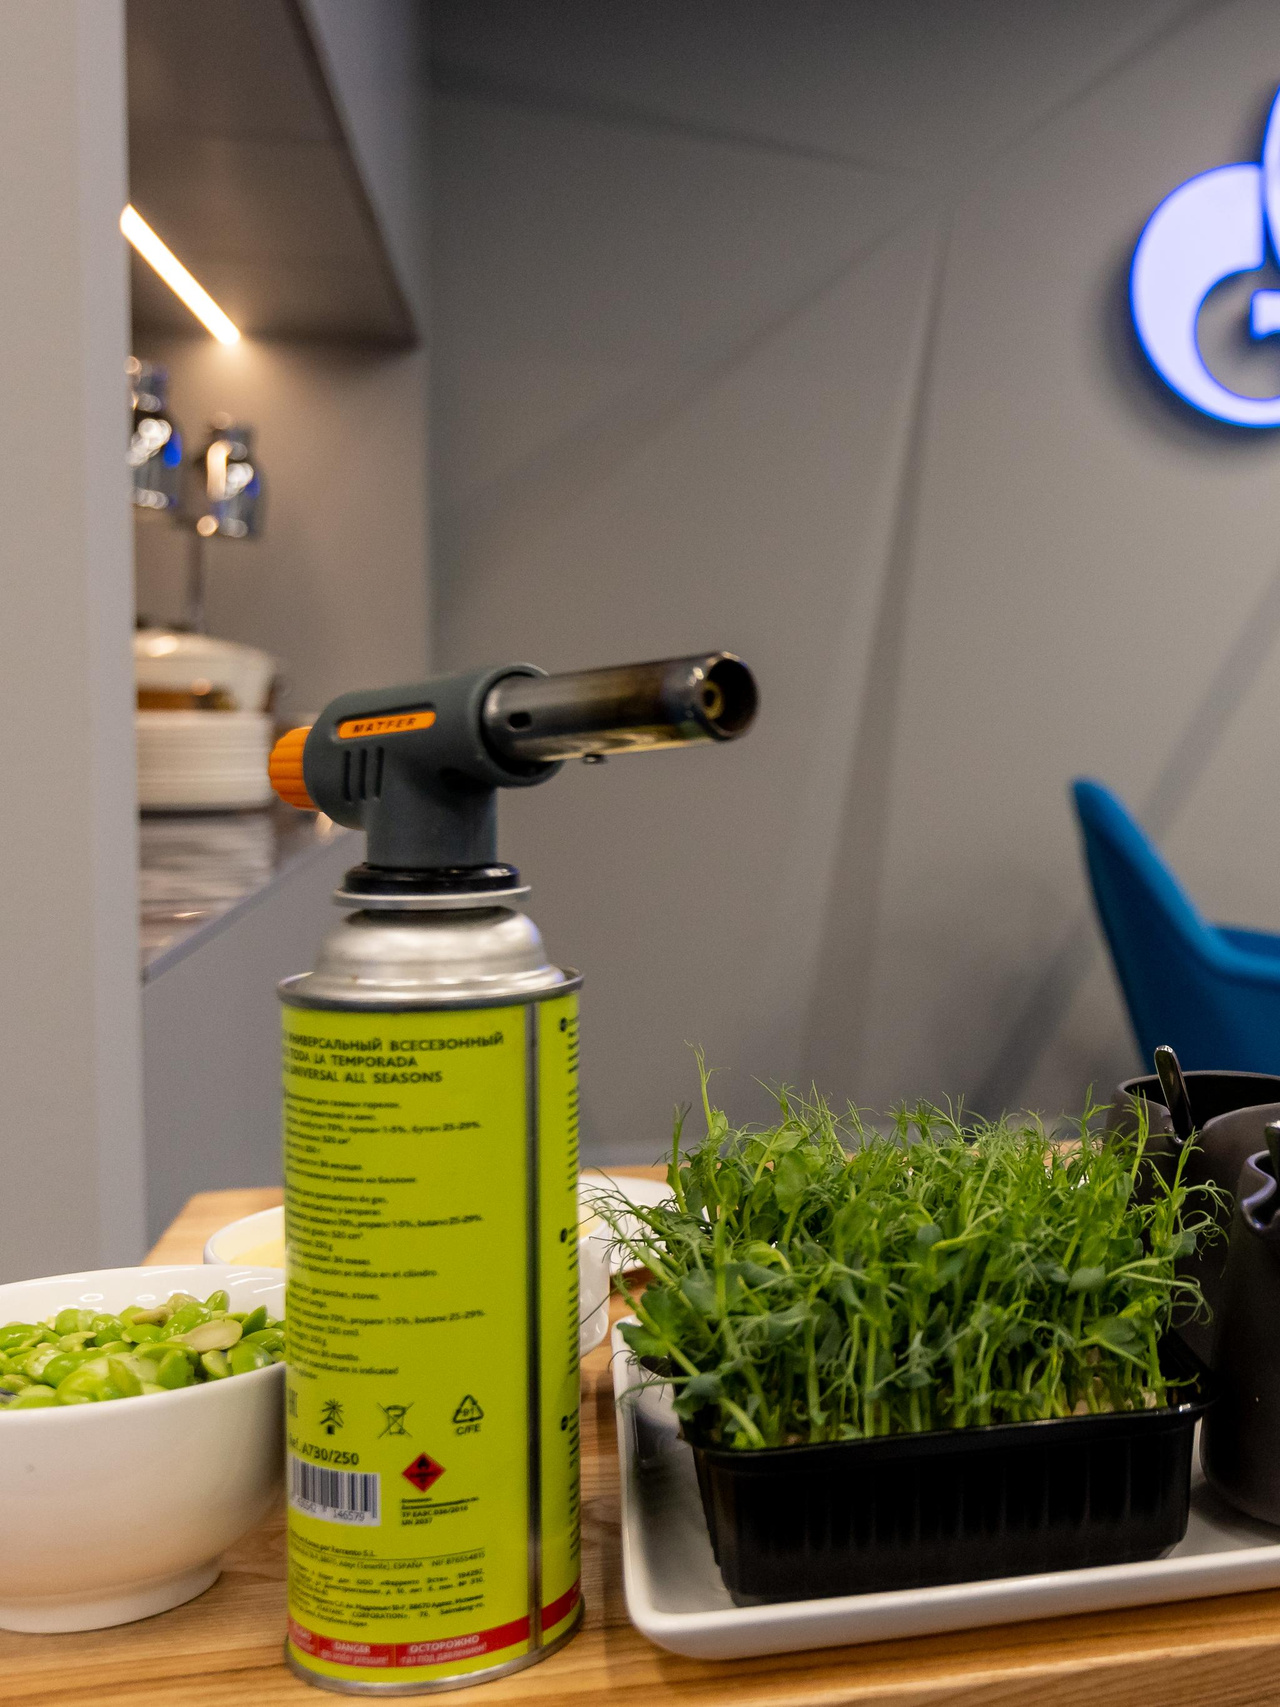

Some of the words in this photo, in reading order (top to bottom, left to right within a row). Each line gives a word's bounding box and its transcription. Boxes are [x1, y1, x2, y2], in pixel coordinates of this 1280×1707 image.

[352, 717, 417, 734] MATFER
[390, 1030, 504, 1052] ВСЕСЕЗОННЫЙ
[290, 1047, 311, 1062] TODA
[331, 1054, 418, 1068] TEMPORADA
[345, 1072, 367, 1084] ALL
[373, 1070, 442, 1084] SEASONS
[302, 1442, 360, 1466] A730/250
[334, 1641, 371, 1655] DANGER
[409, 1634, 480, 1654] ОСТОРОЖНО
